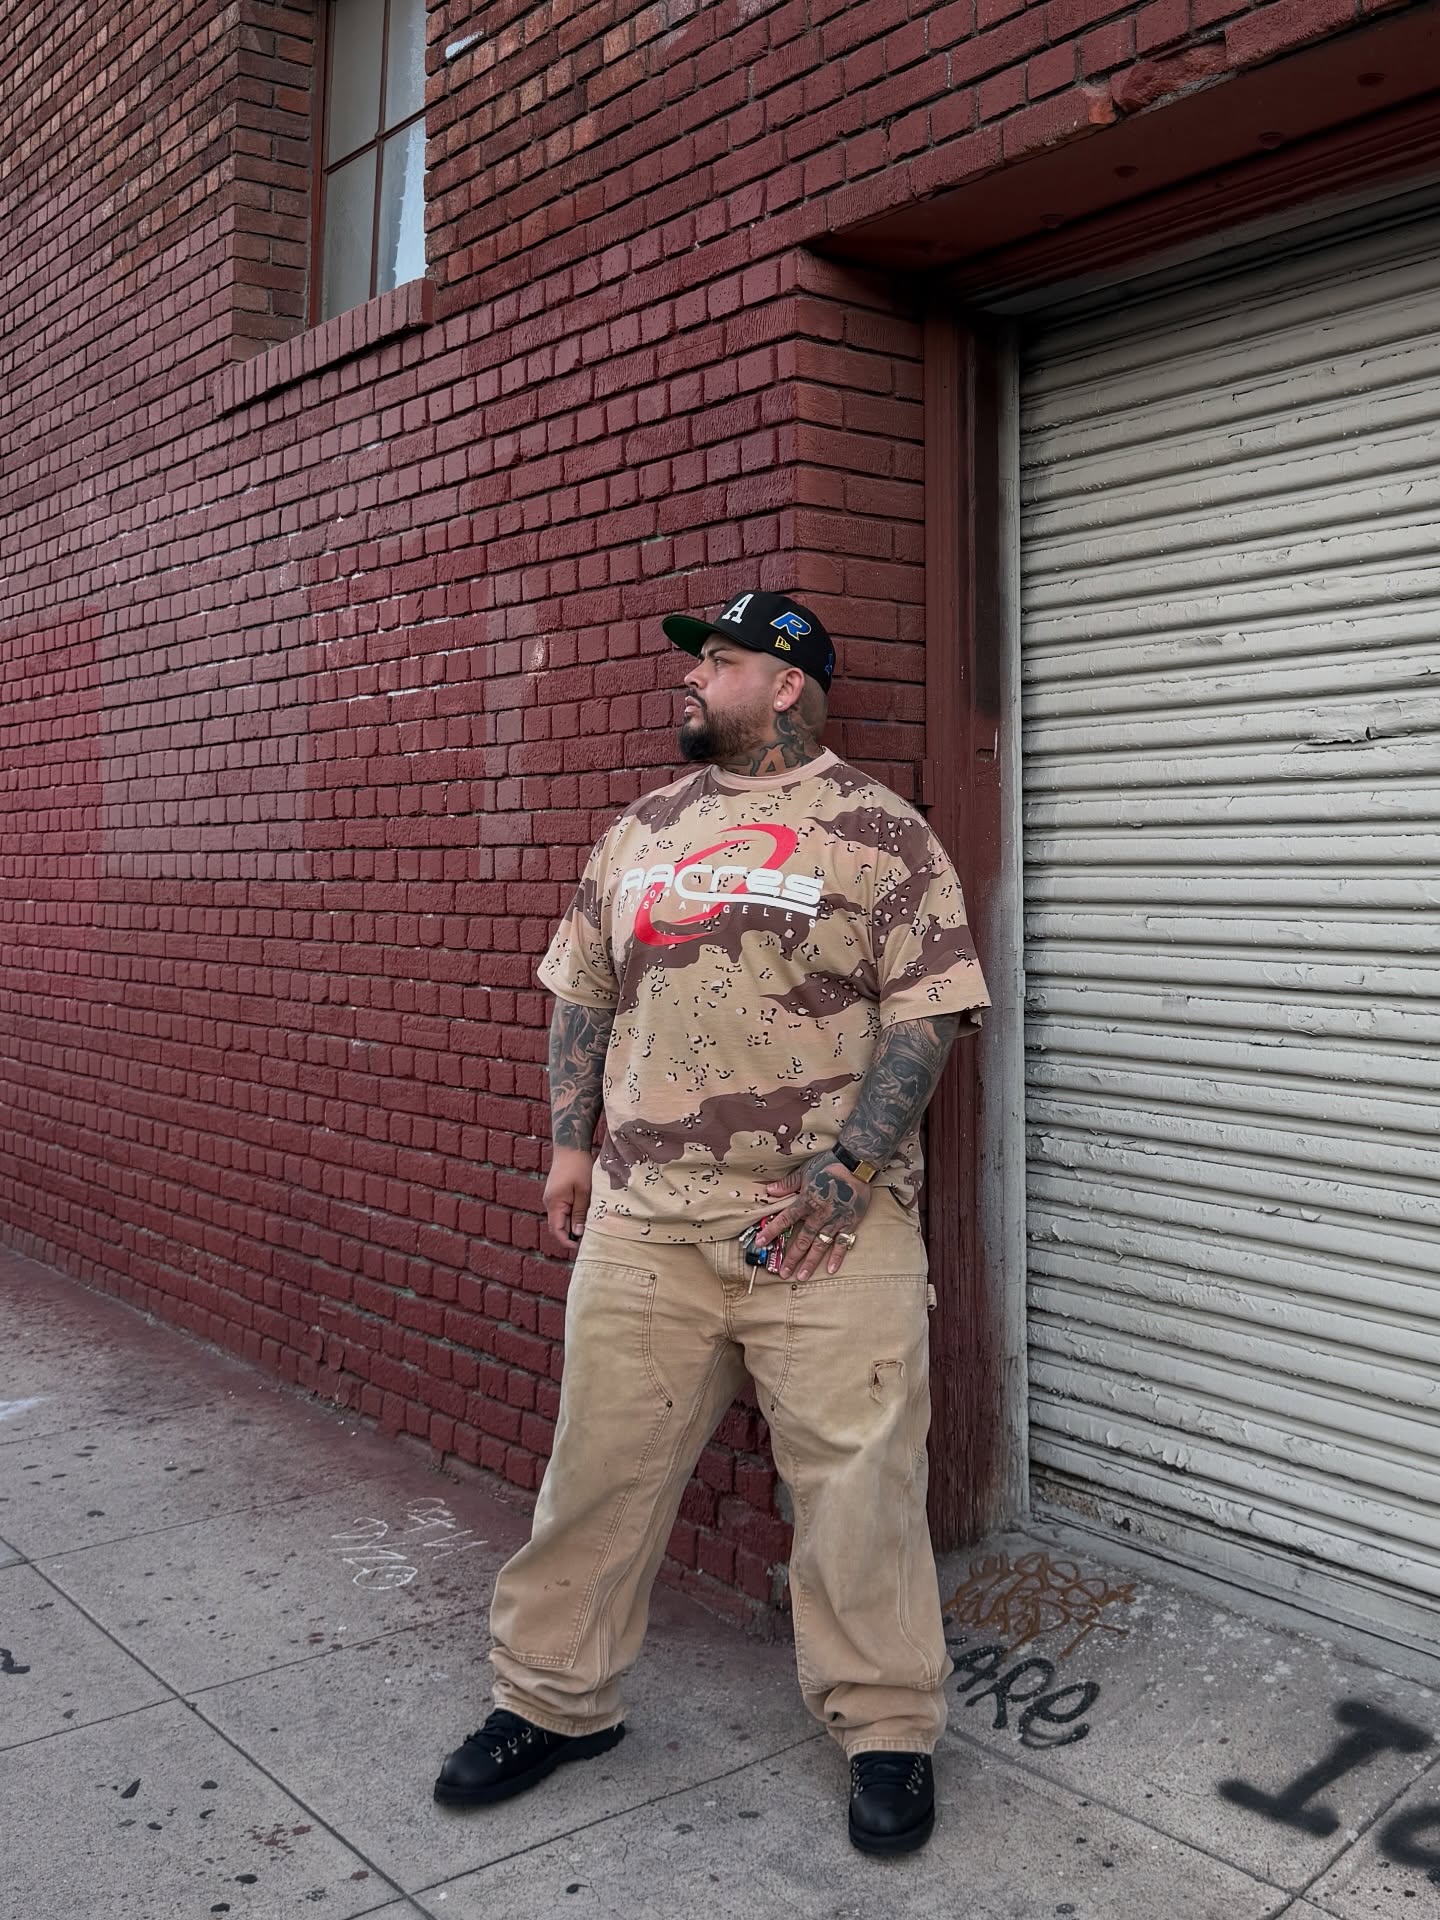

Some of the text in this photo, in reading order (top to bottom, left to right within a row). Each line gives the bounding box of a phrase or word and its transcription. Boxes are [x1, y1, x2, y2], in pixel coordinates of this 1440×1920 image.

[721, 593, 754, 624] A
[769, 611, 812, 641] R
[679, 900, 817, 929] ANGELES
